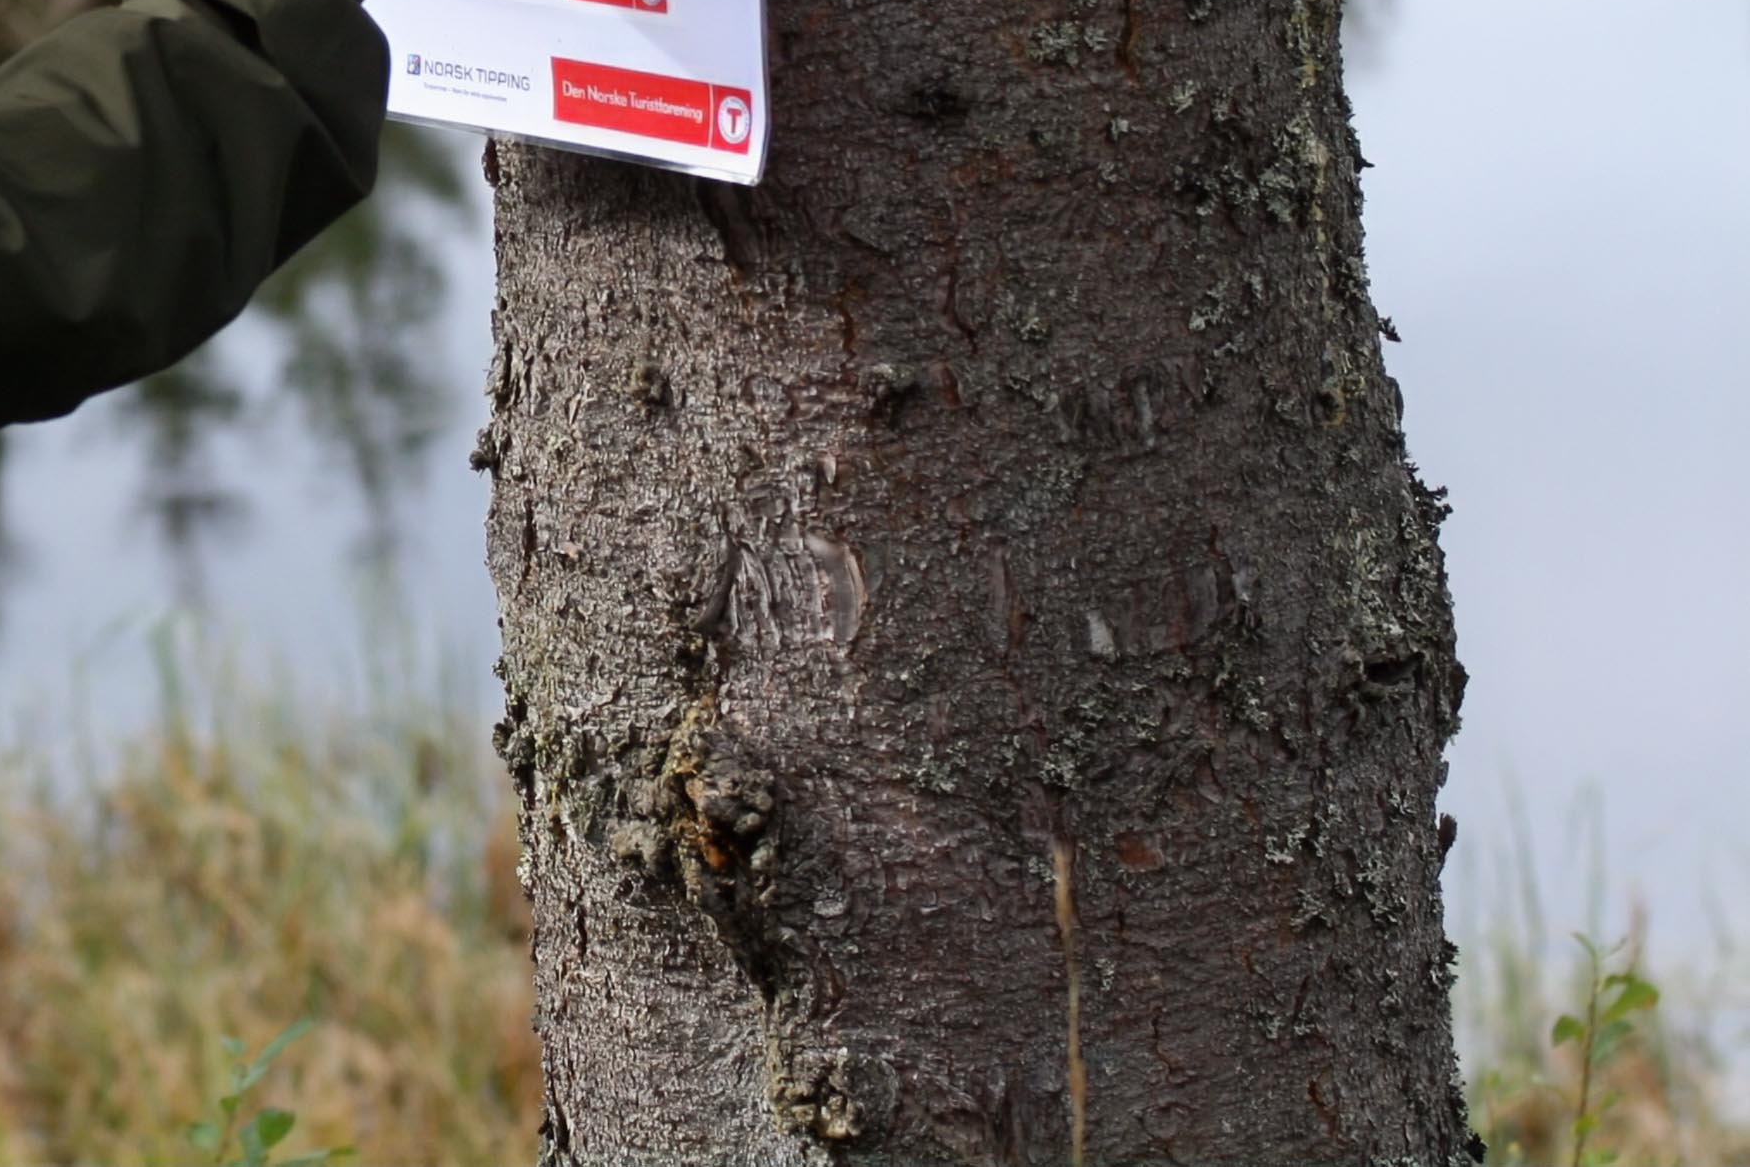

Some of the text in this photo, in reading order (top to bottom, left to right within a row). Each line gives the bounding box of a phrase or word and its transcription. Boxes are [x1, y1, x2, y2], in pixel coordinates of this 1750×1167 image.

[424, 59, 473, 82] NORSK
[475, 67, 531, 92] TIPPING
[561, 80, 704, 124] Den Norske Turistforening
